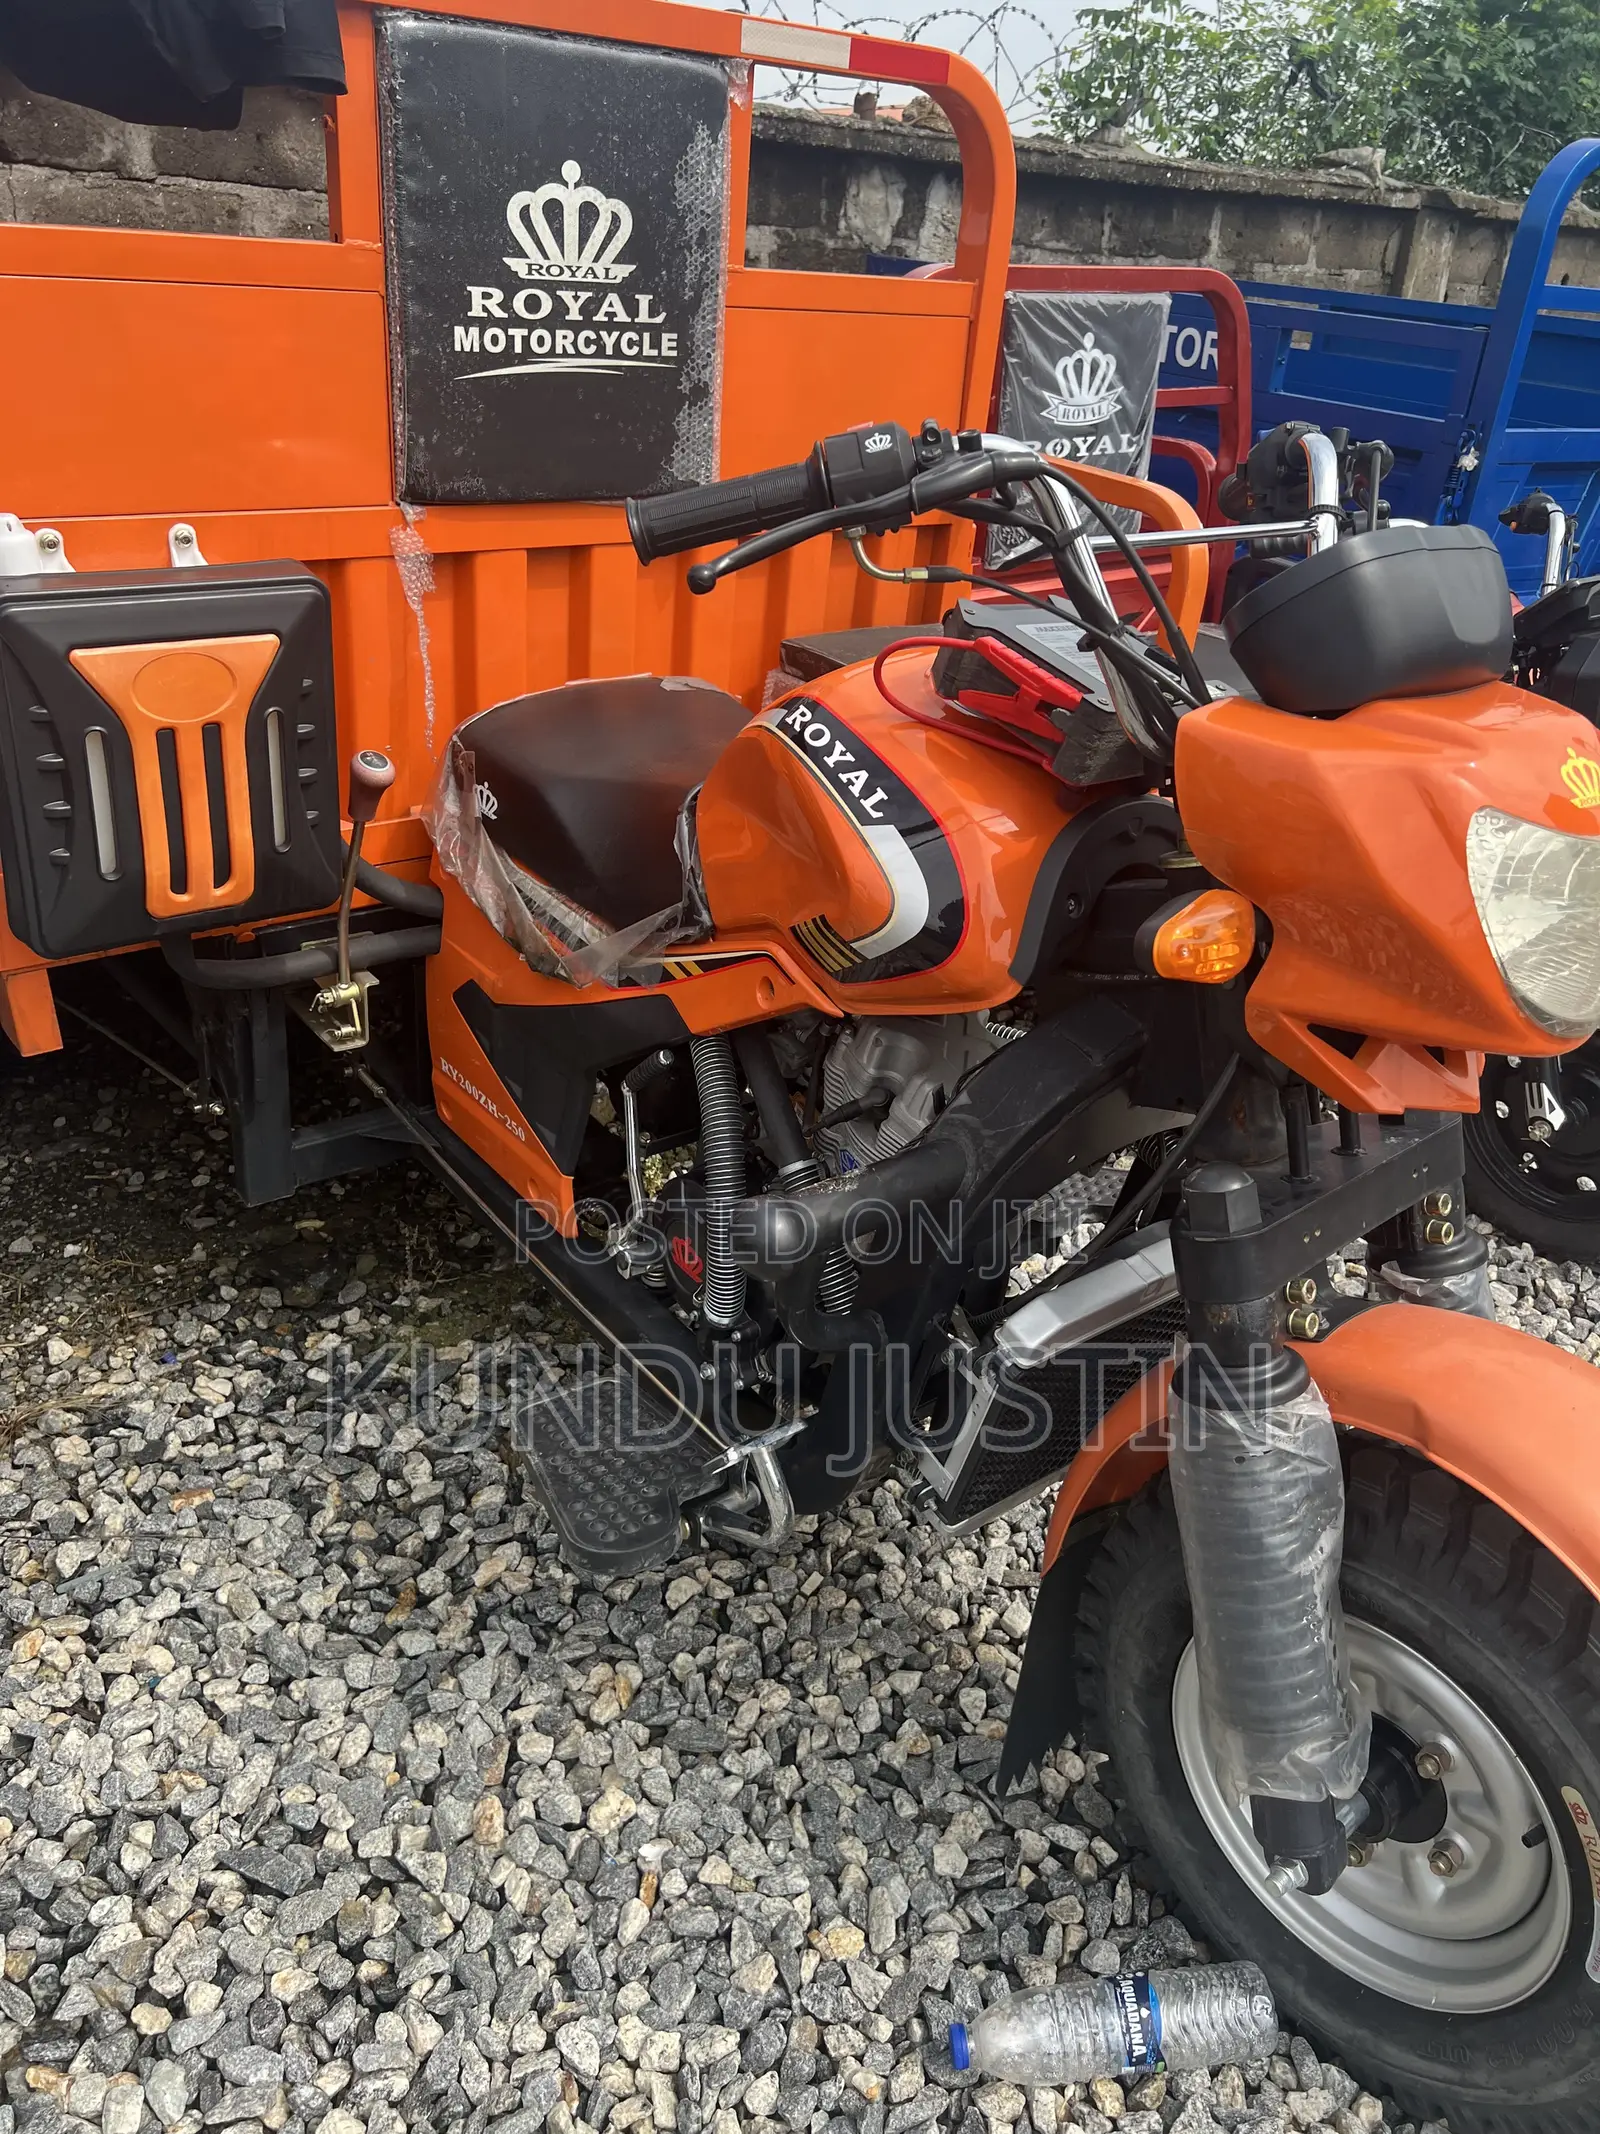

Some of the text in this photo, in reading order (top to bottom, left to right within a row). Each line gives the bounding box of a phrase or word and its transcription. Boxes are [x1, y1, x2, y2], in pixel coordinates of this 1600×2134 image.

[525, 263, 620, 280] ROYAL
[466, 286, 668, 324] ROYAL
[453, 326, 679, 357] MOTORCYCLE
[1061, 405, 1105, 421] ROYAL
[785, 704, 889, 819] ROYAL
[440, 1056, 526, 1142] RY200ZH-250
[1118, 1979, 1148, 2057] AQUADANA
